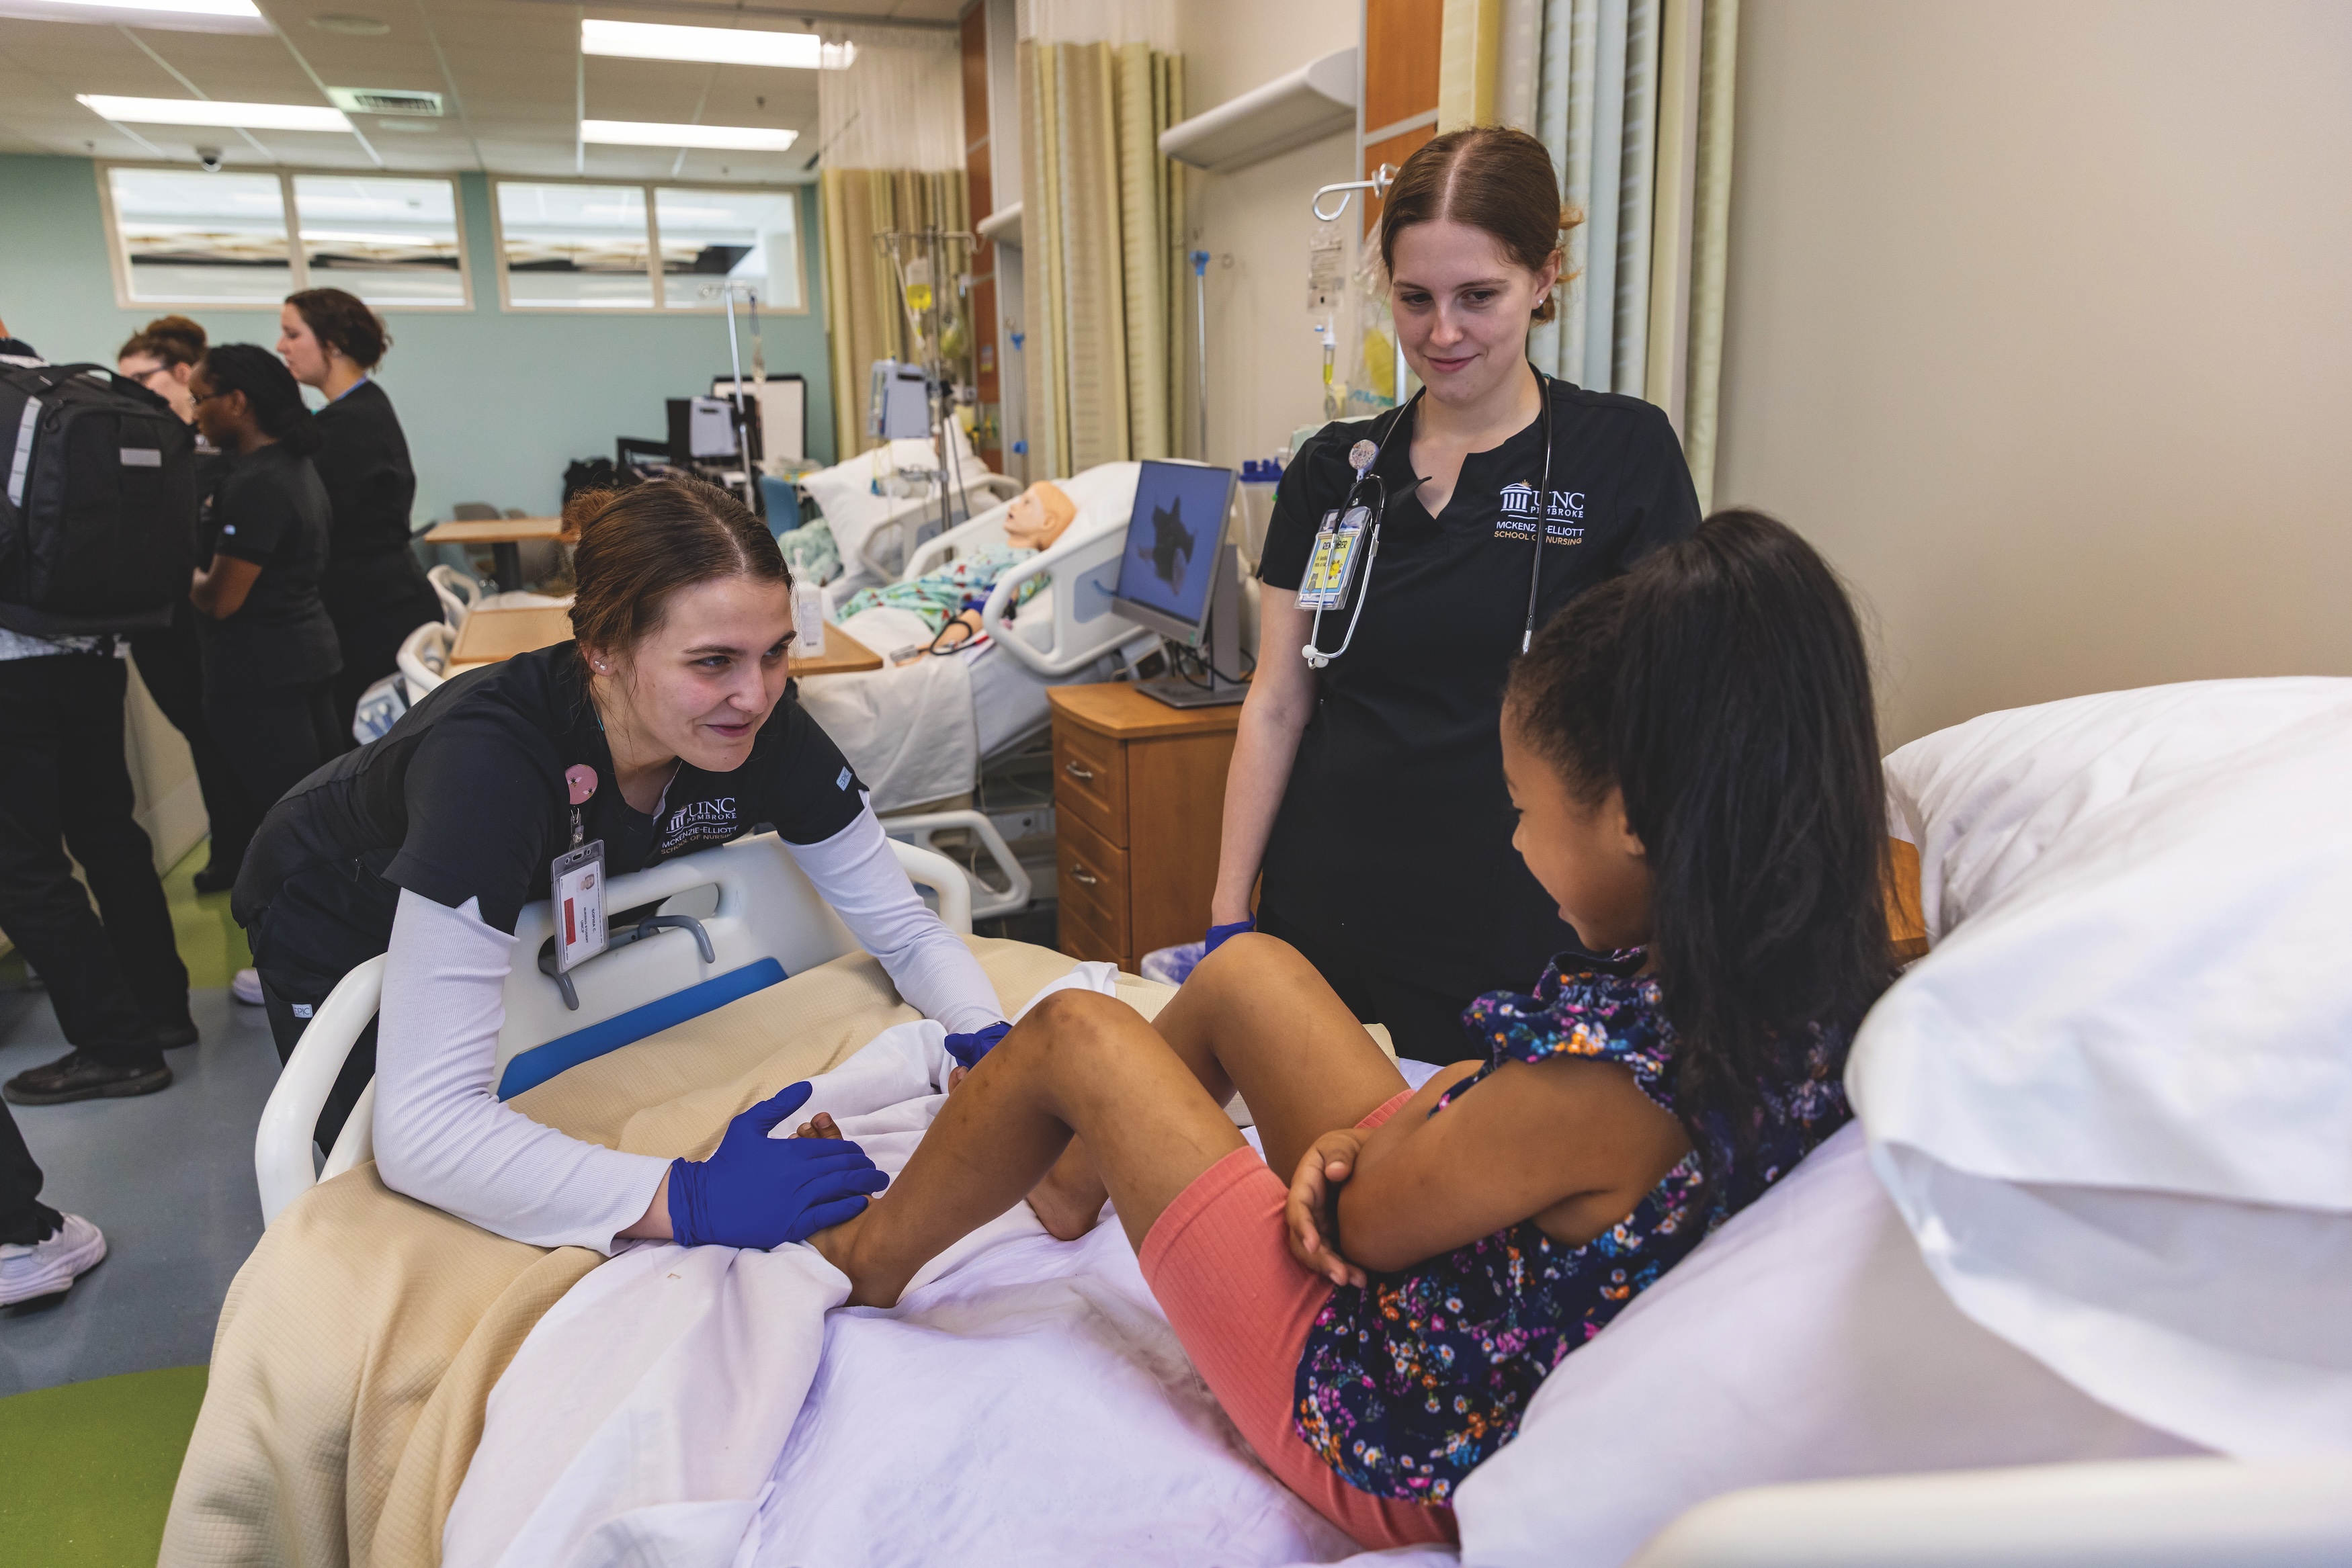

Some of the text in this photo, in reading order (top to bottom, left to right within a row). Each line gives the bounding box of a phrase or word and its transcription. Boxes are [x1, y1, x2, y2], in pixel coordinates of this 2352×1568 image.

[1532, 490, 1585, 511] UNC
[1496, 521, 1585, 537] MCKENZ-ELLIOTT
[1494, 530, 1529, 541] SCHOOL
[1545, 535, 1583, 546] NURSING
[687, 797, 736, 817] UNC
[687, 812, 737, 824] PEMBROKE
[662, 825, 739, 848] MCKENZIE-ELLIOTT
[661, 838, 689, 855] SCHOOL
